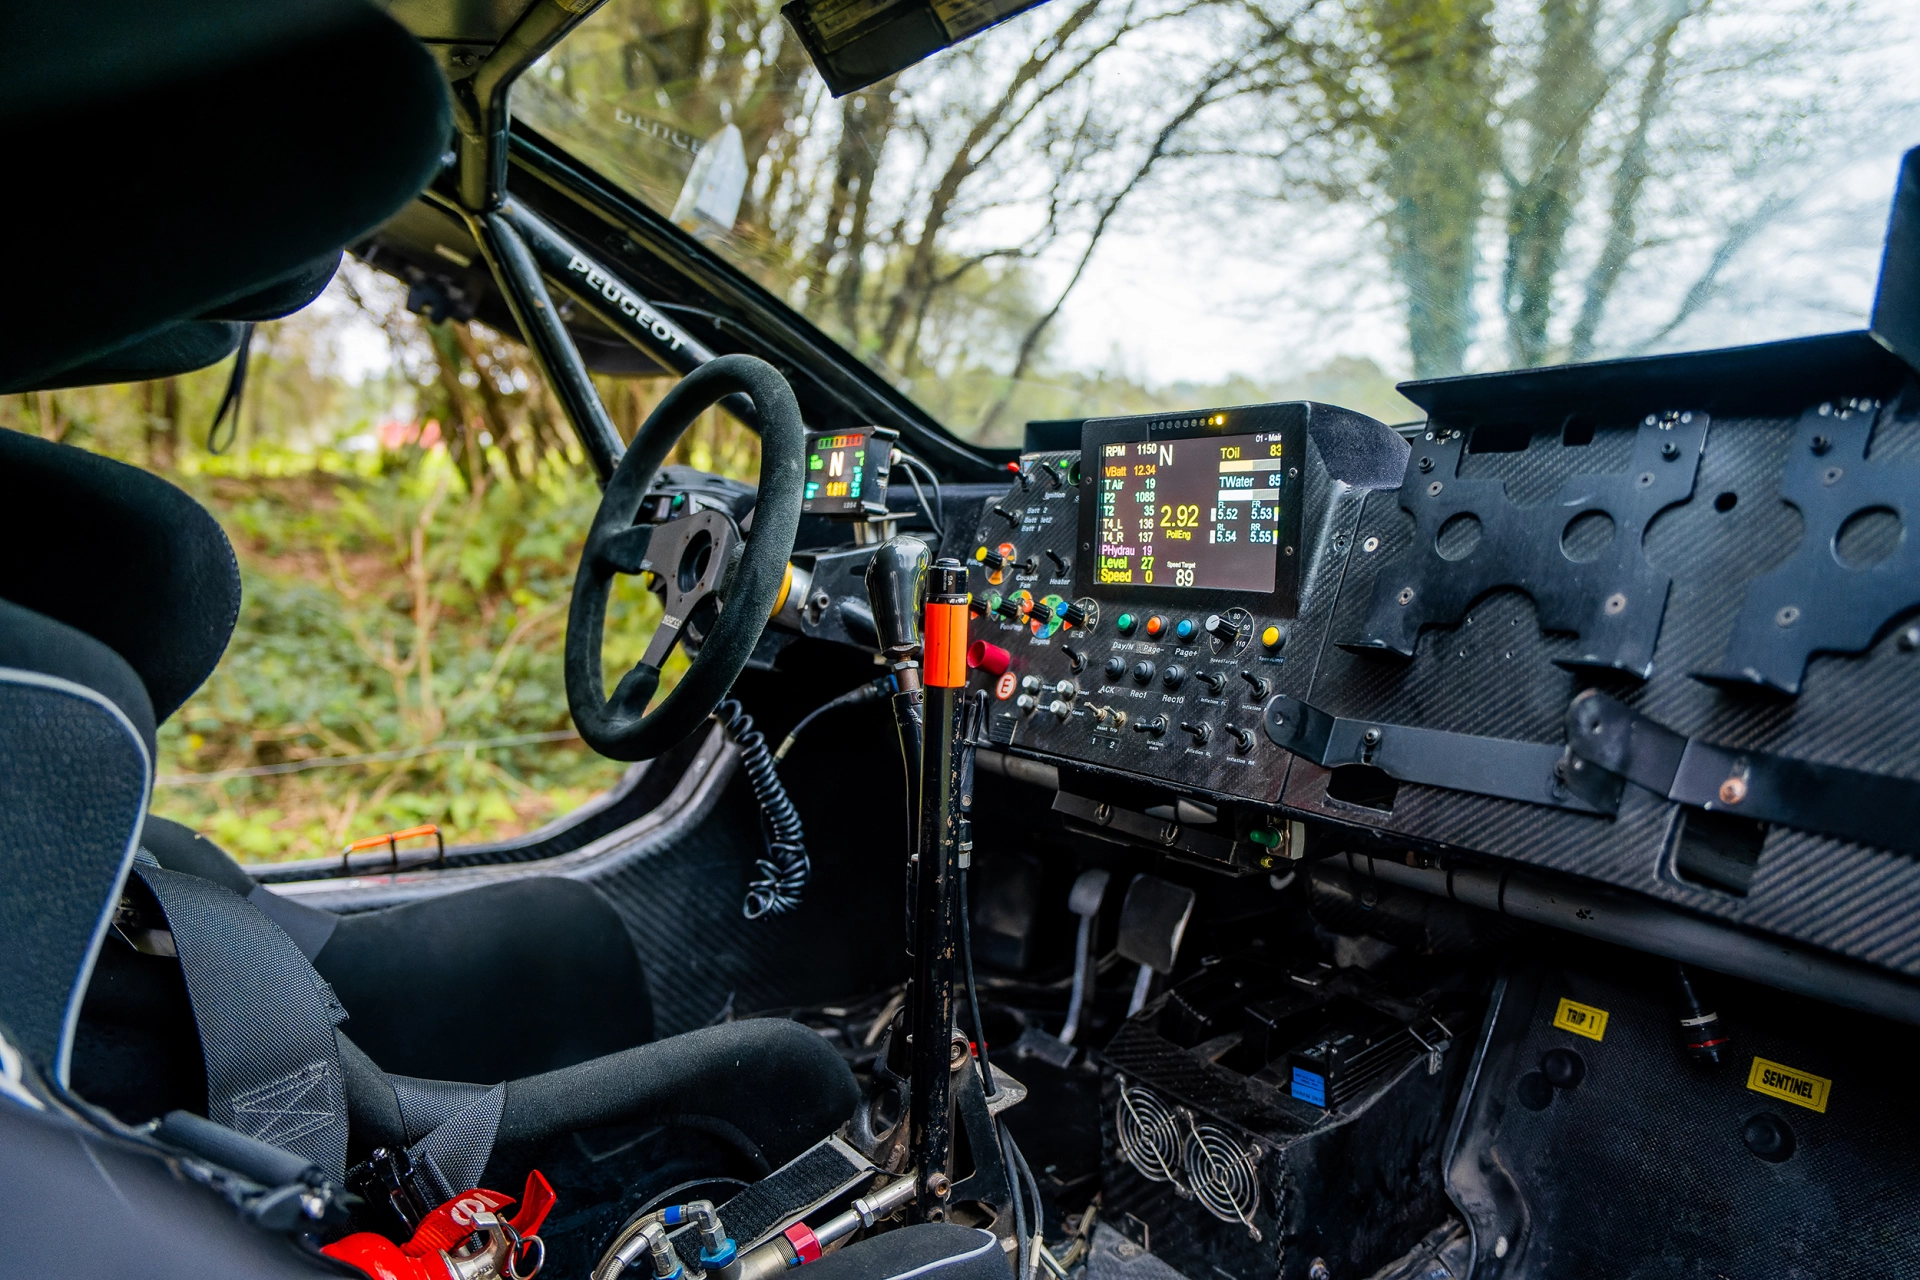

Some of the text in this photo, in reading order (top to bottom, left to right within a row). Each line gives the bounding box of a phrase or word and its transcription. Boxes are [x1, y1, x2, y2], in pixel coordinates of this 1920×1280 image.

[567, 256, 687, 351] PEUGEOT
[1106, 443, 1157, 456] RPM 1150
[1159, 445, 1173, 466] N
[1220, 444, 1282, 459] TOil 83
[829, 451, 845, 477] N
[1105, 464, 1156, 477] VBatt 12.34
[1104, 478, 1156, 490] T Air 19
[1219, 473, 1281, 488] TWater 85
[1044, 492, 1066, 500] Ignition
[1104, 492, 1155, 503] P2 1088
[1103, 505, 1155, 516] T2 35
[1218, 500, 1261, 509] FL FR
[1160, 504, 1199, 527] 2.92
[1217, 507, 1272, 520] 5.52 5.53
[1103, 518, 1154, 531] T4_L 136
[1217, 523, 1260, 531] RL RR
[1102, 531, 1153, 544] T4_R 137
[1216, 530, 1271, 542] 5.54 5.55
[1101, 545, 1152, 558] PHydrau 19
[1101, 556, 1154, 570] Level 27
[1166, 561, 1182, 569] Speed
[1100, 569, 1153, 584] Speed 0
[1175, 569, 1194, 587] 89
[1030, 638, 1050, 646] Engine
[1143, 645, 1164, 654] Page-
[1175, 648, 1198, 657] Page+
[1000, 678, 1011, 694] E
[1100, 685, 1115, 694] ACK
[1130, 690, 1147, 698] Rec1
[1162, 694, 1185, 704] Rec10
[1091, 737, 1096, 745] 1
[1109, 741, 1115, 749] 2
[1226, 756, 1245, 764] Inflation
[1567, 1008, 1595, 1029] TRIP 1
[1762, 1069, 1813, 1099] SENTINEL
